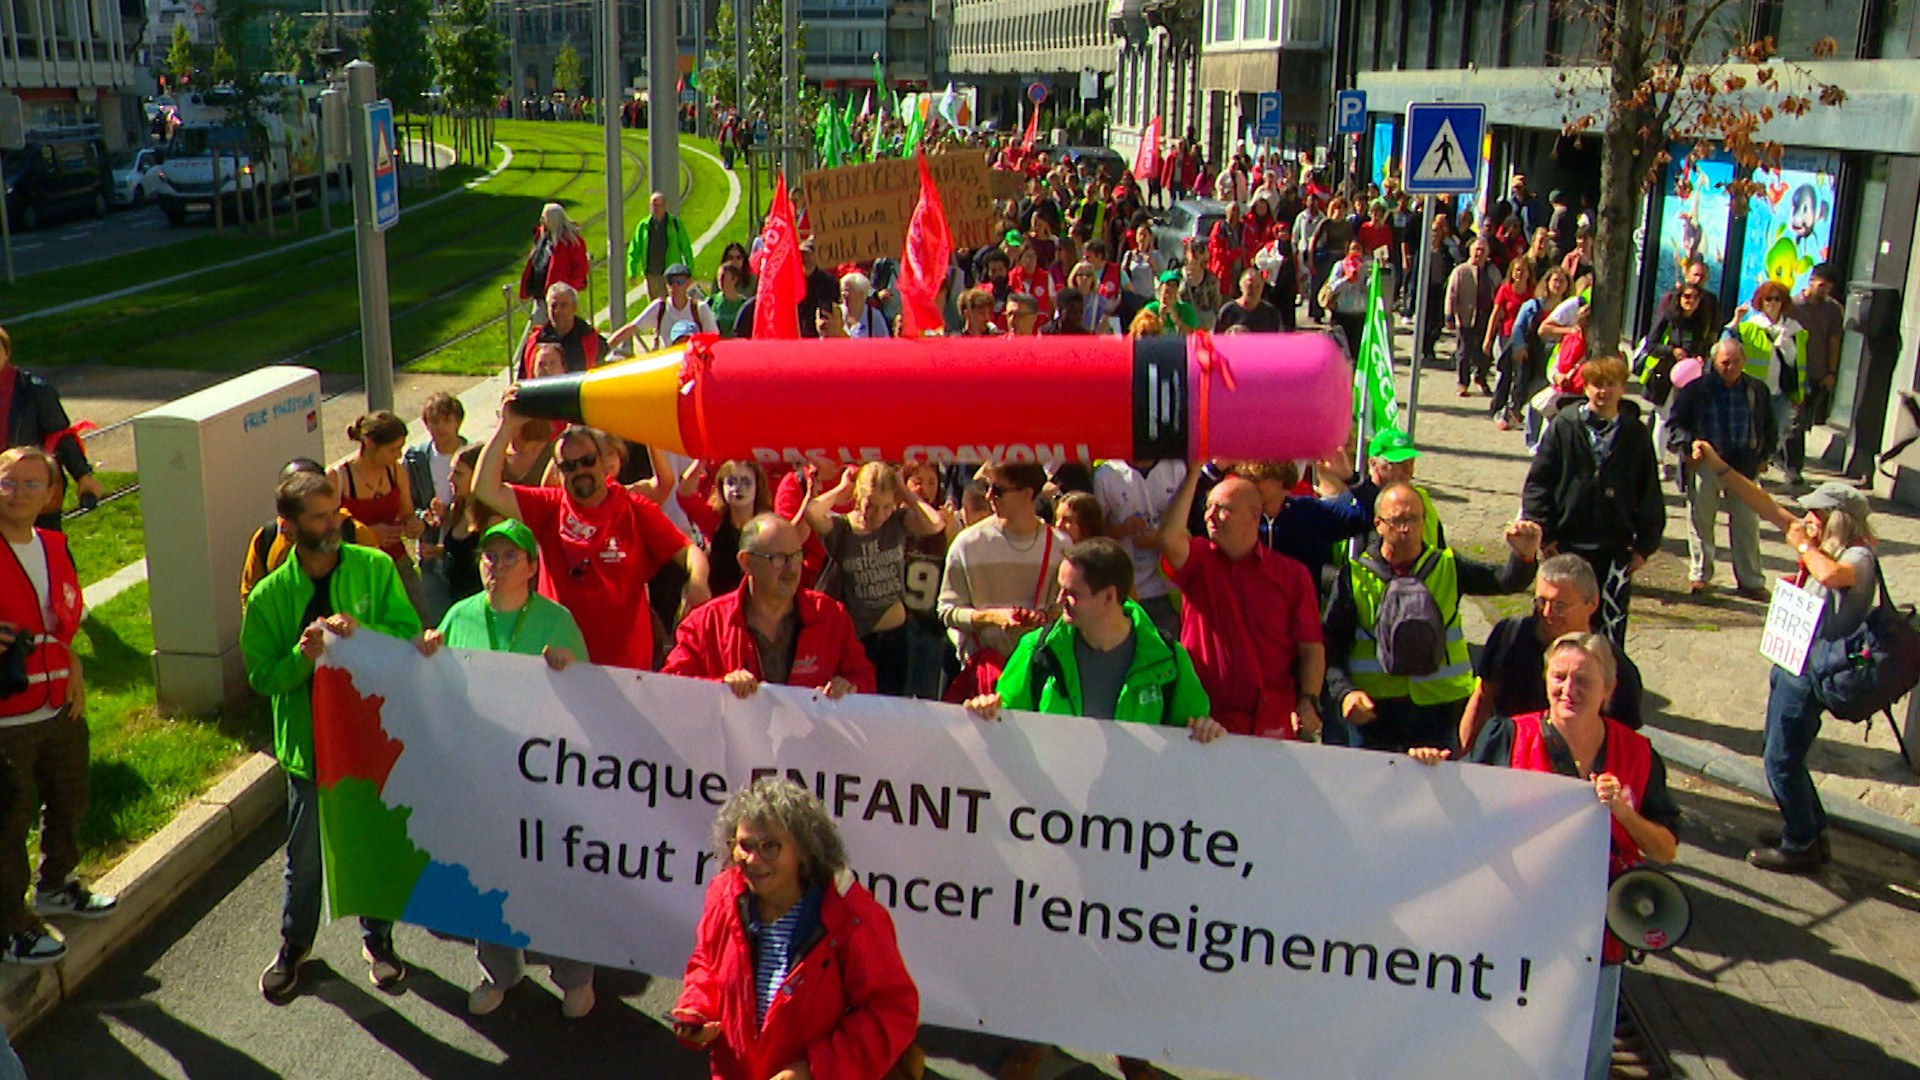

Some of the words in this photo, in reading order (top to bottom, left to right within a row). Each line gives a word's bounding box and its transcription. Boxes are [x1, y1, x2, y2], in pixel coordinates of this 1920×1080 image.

[1261, 97, 1278, 120] P
[1341, 97, 1363, 127] P
[902, 561, 940, 611] 9
[517, 736, 728, 809] Chaque
[1009, 806, 1255, 880] compte,
[519, 817, 544, 863] Il
[561, 823, 676, 883] faut
[1012, 877, 1495, 1003] l'enseignement
[1515, 956, 1533, 1008] !
